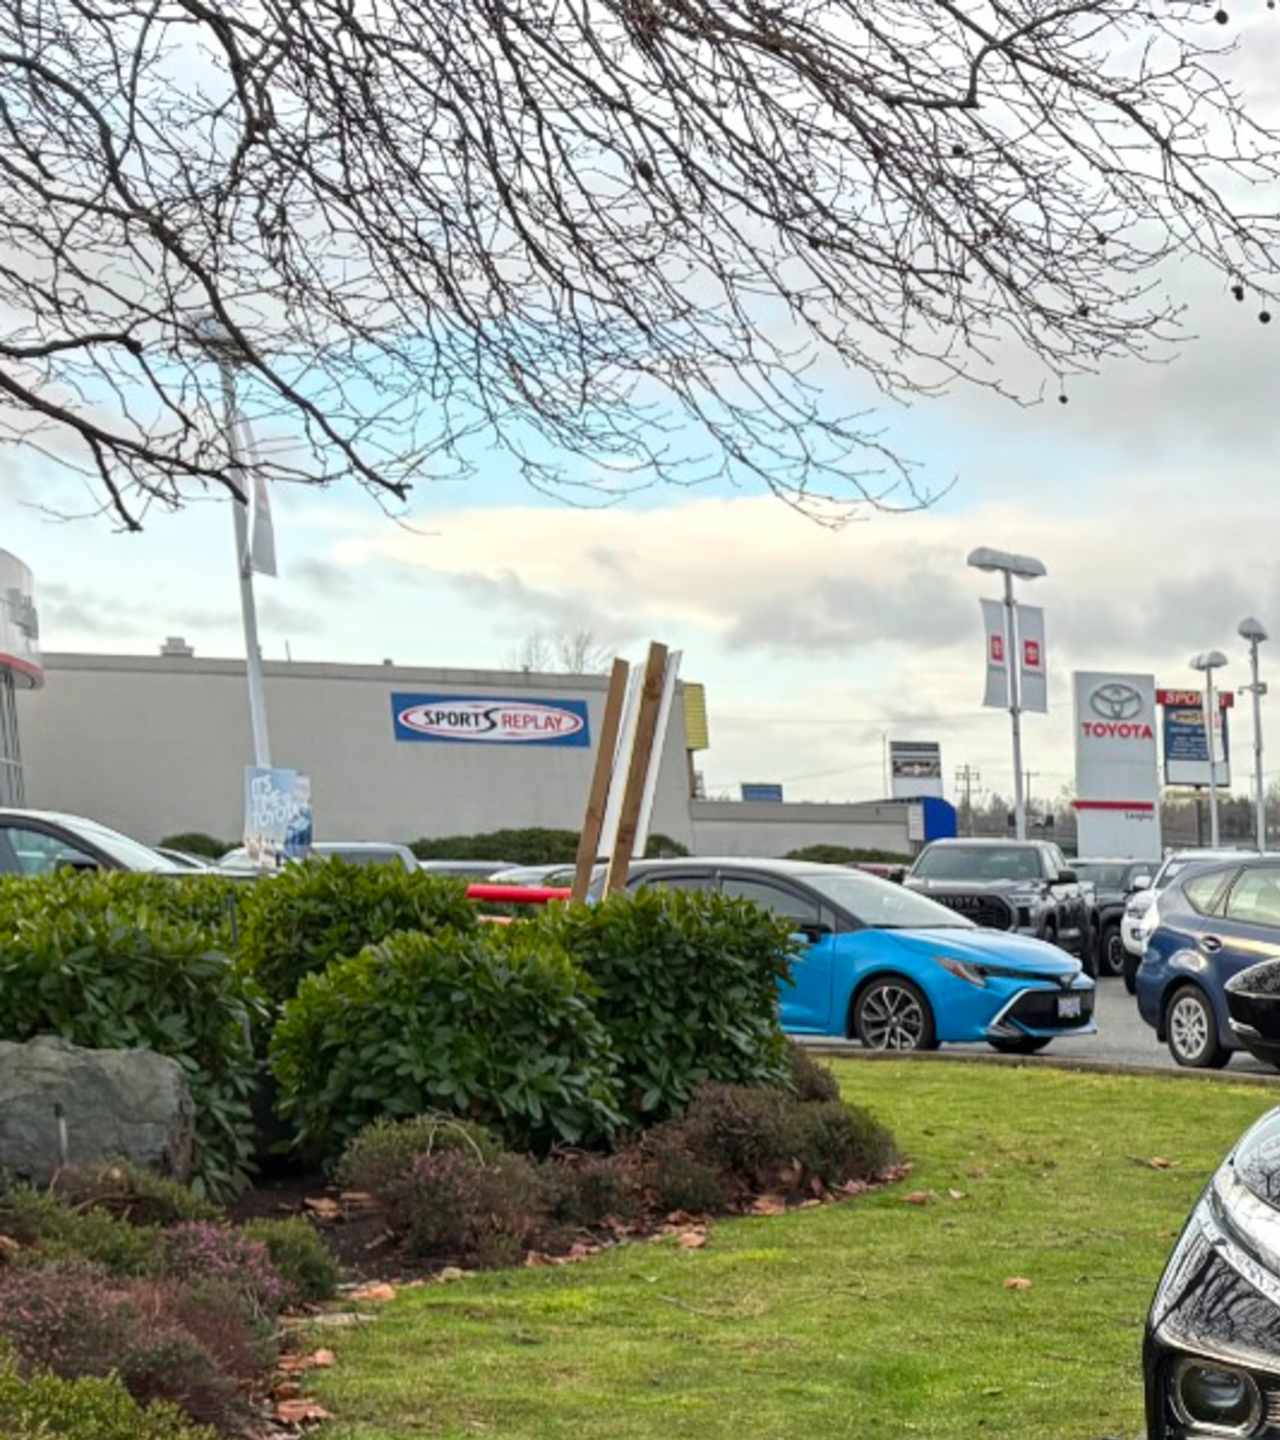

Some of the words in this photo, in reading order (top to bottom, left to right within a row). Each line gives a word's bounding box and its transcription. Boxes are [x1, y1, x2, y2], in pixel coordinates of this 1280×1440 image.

[424, 708, 500, 732] SPORTS
[501, 713, 563, 730] REPLAY
[1083, 722, 1153, 739] TOYOTA
